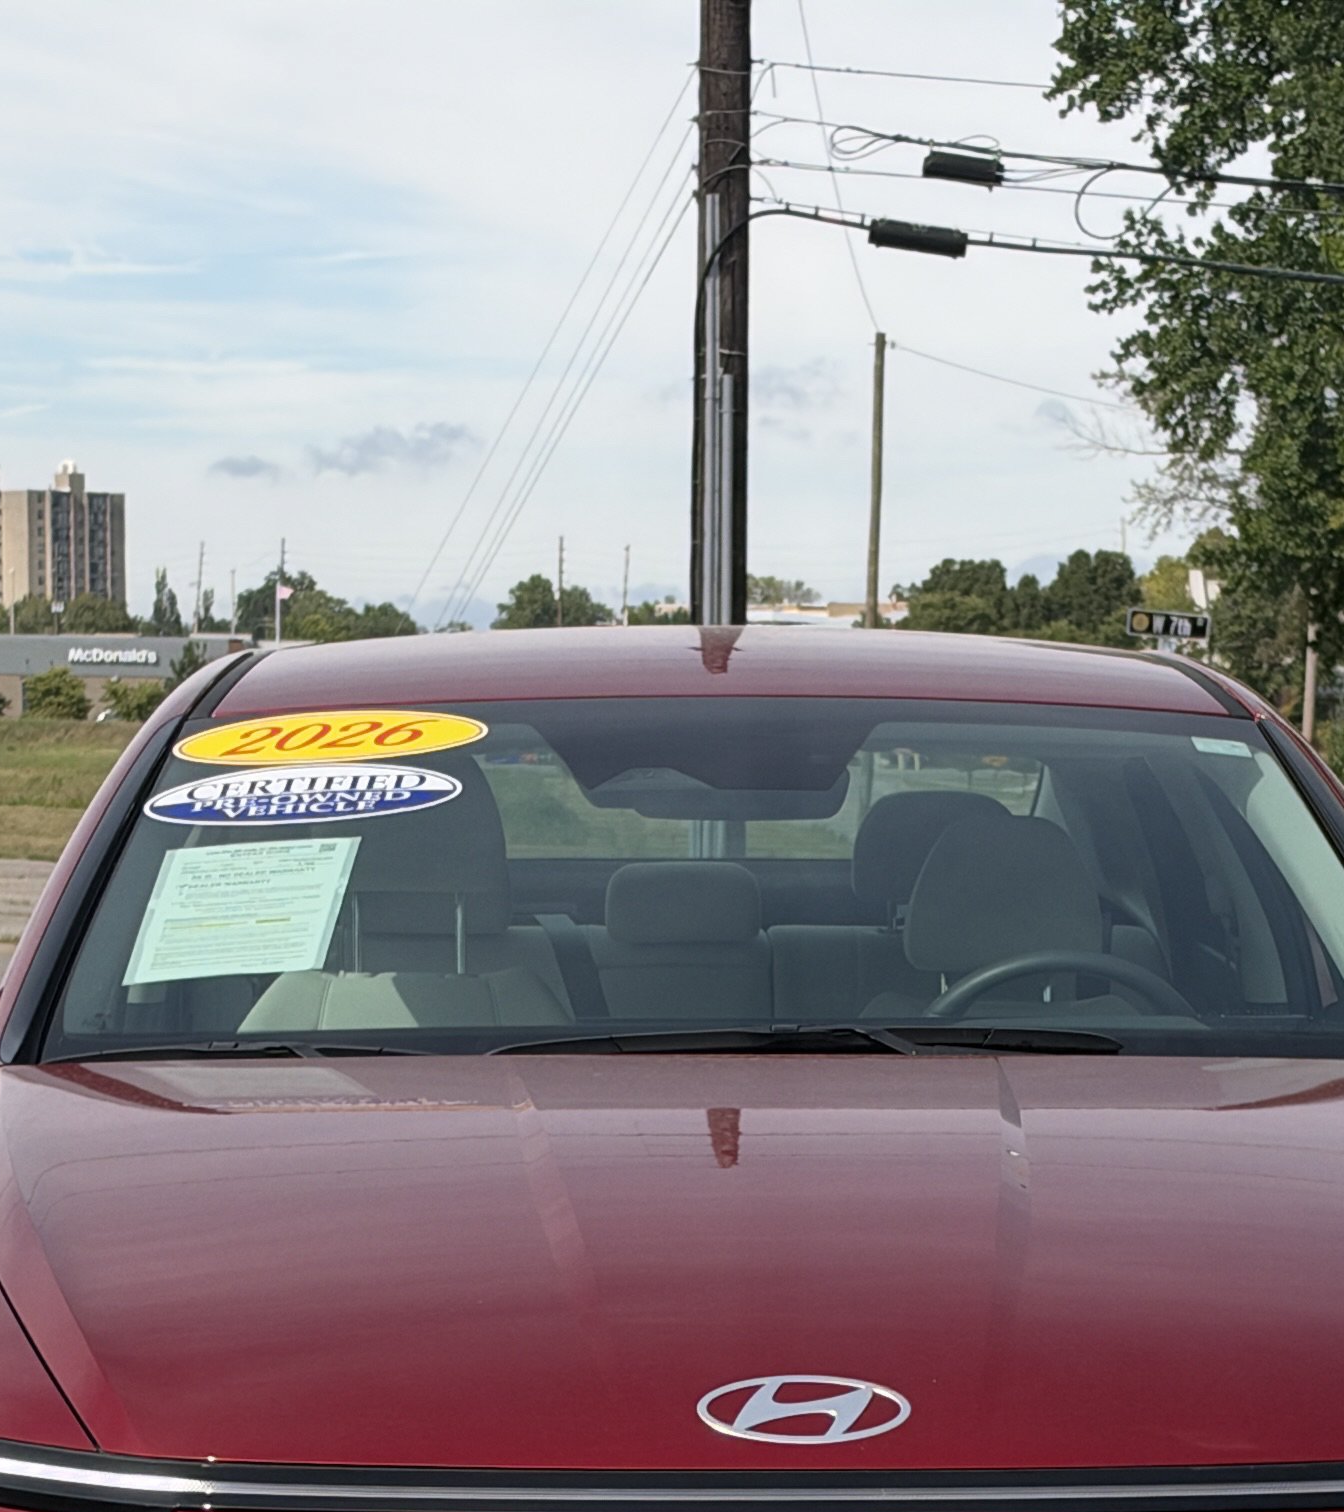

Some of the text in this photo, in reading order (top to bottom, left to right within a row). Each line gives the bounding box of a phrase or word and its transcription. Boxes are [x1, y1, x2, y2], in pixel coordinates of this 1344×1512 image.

[67, 647, 158, 664] McDonald's
[219, 719, 440, 758] 2026
[188, 773, 426, 802] CERTIFIED
[193, 790, 411, 812] PRE-OWNED
[222, 800, 376, 819] VEHICLE
